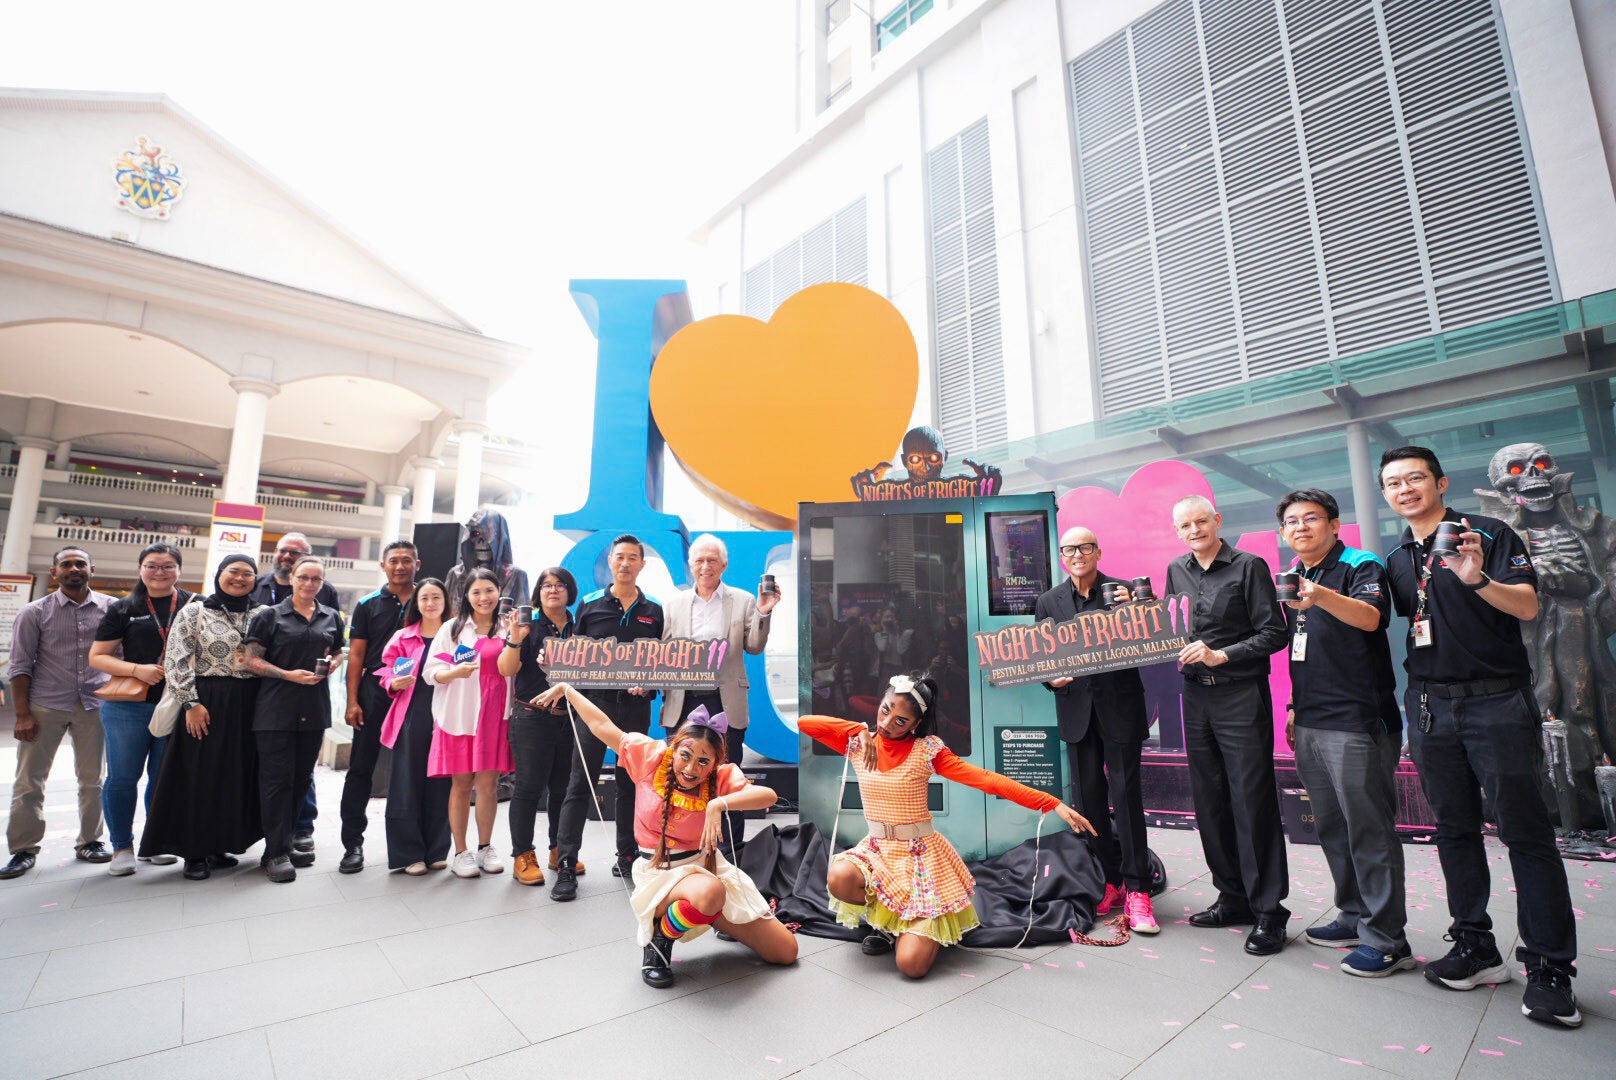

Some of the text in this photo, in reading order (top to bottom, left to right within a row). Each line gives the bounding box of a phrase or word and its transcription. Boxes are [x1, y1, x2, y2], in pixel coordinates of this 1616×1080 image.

[863, 482, 912, 501] NIGHTS
[914, 484, 926, 497] OF
[927, 479, 977, 499] FRIGHT
[219, 531, 247, 543] ASU
[1005, 576, 1027, 586] RM78
[975, 595, 1189, 666] NIGHTS OF FRIGHT 11
[543, 638, 728, 671] NIGHTS OF FRIGHT 11
[991, 637, 1187, 680] FESTIVAL OF FEAR AT SUNWAY LAGOON, MALAYSIA
[549, 670, 715, 682] FESTIVAL OF FEAR AT SUNWAY LAGOON, MALAYSIA
